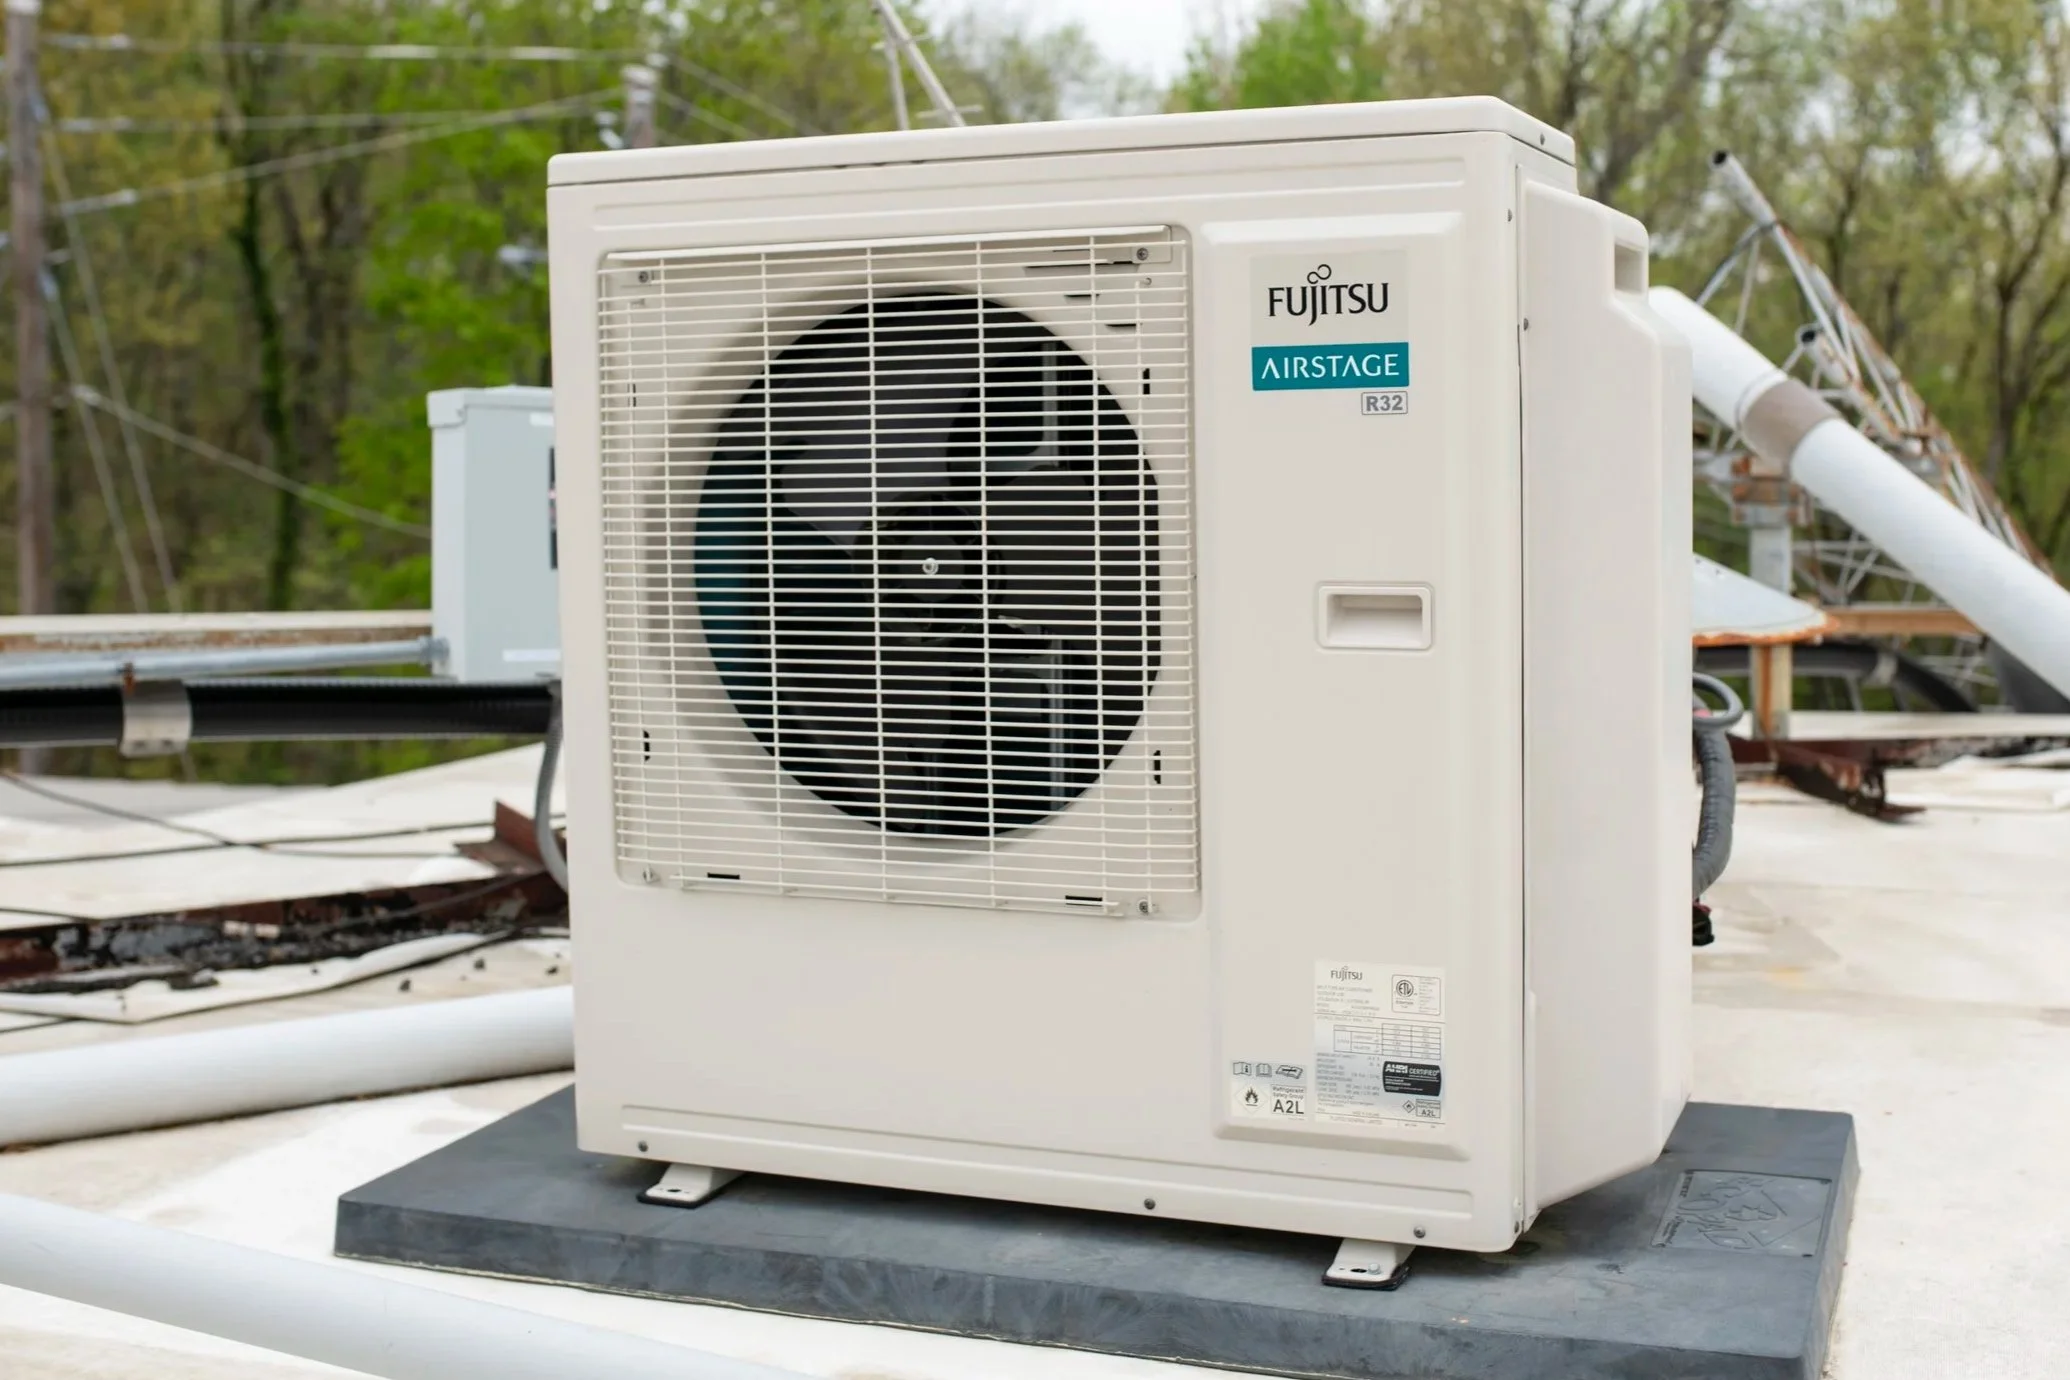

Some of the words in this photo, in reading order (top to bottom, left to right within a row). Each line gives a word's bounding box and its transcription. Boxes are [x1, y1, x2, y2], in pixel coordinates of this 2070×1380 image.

[1268, 264, 1389, 326] FUJITSU
[1261, 354, 1400, 379] AIRSTAGE
[1365, 395, 1404, 412] R32
[1330, 966, 1363, 981] FUJITSU
[1273, 1099, 1304, 1115] A2L
[1421, 1108, 1436, 1118] A2L
